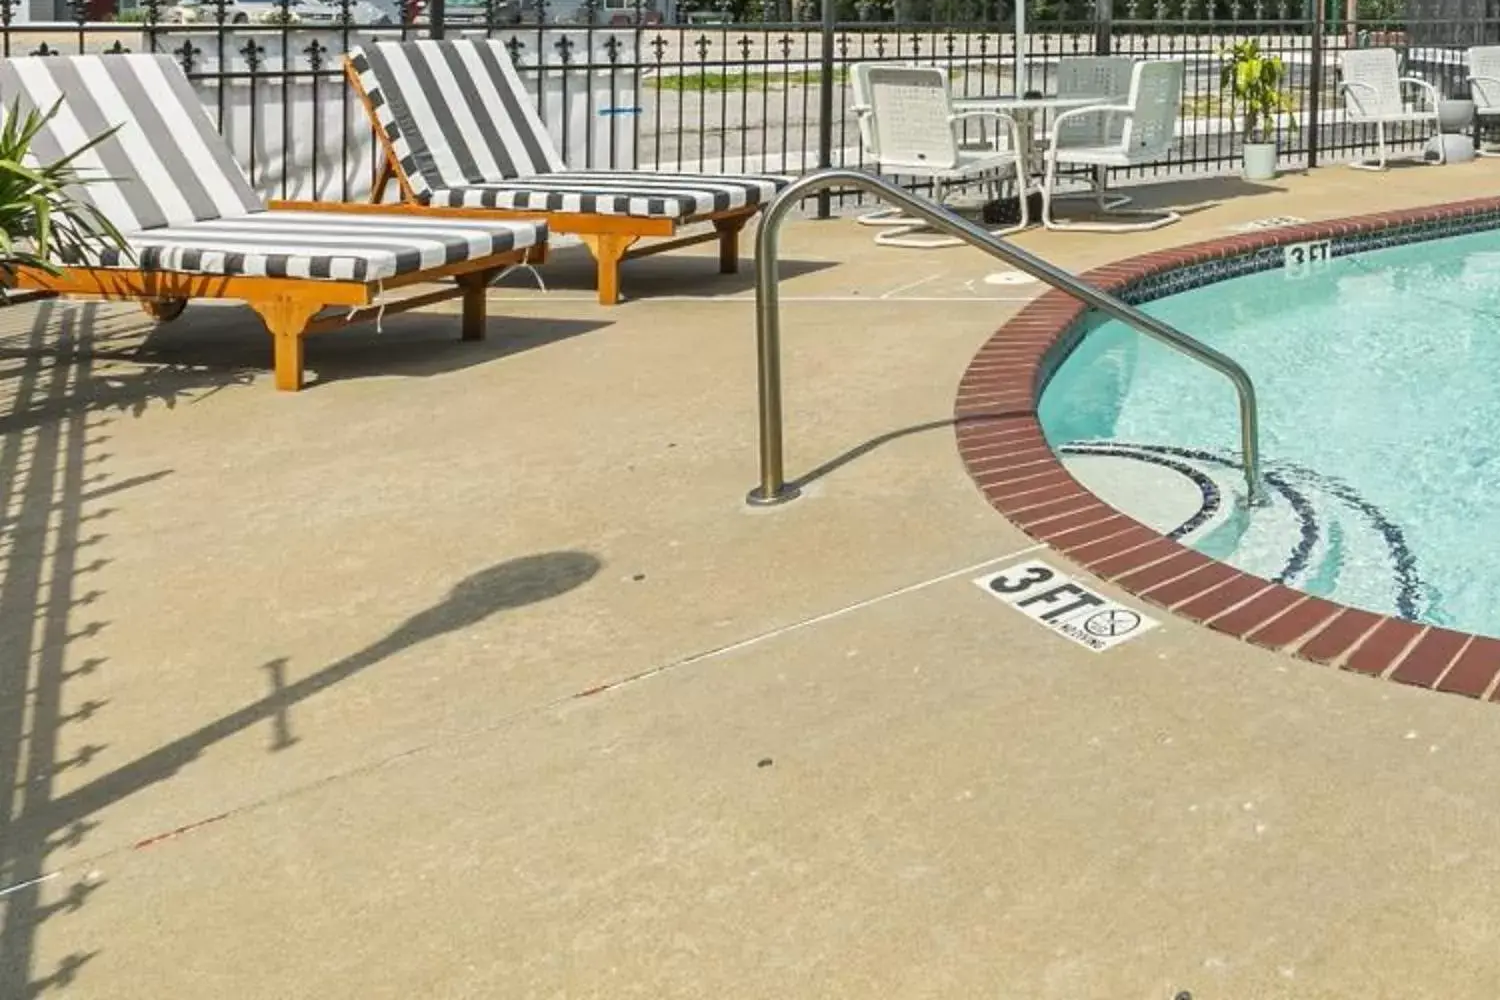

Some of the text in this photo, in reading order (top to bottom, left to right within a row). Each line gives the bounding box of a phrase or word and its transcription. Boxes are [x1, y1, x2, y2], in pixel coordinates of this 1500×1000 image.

[1291, 242, 1329, 265] 3 FT
[989, 567, 1055, 594] 3
